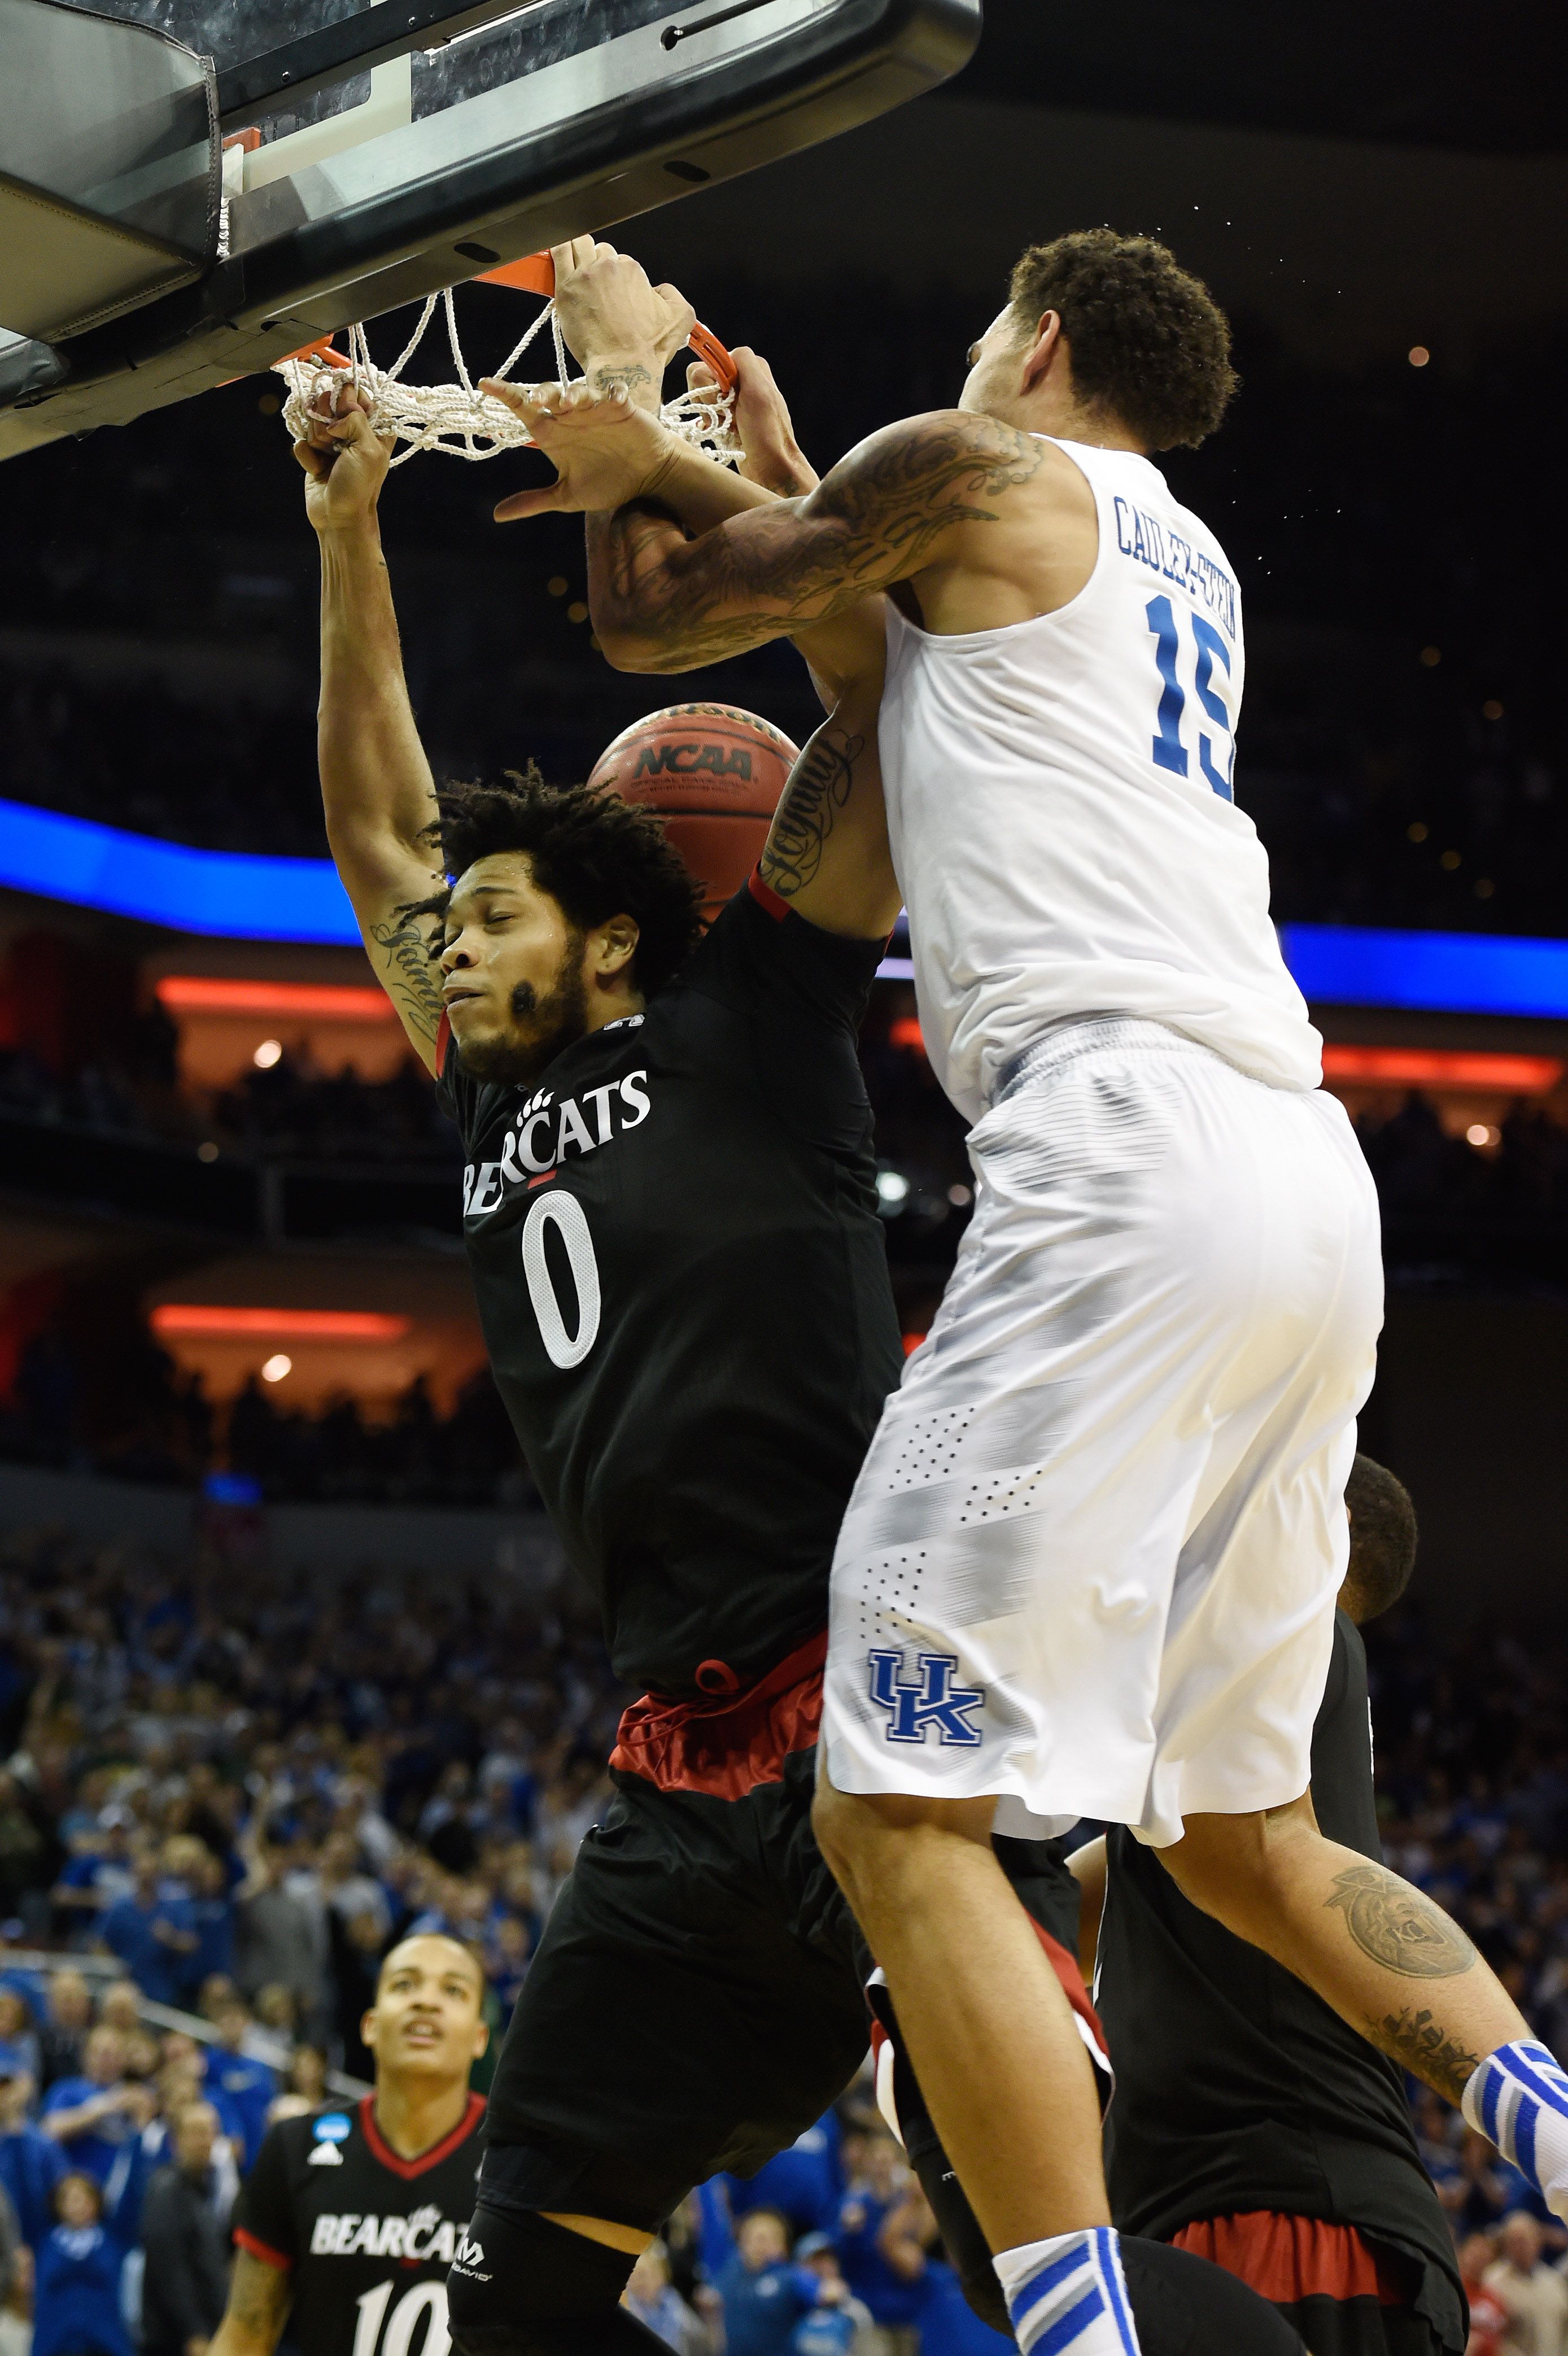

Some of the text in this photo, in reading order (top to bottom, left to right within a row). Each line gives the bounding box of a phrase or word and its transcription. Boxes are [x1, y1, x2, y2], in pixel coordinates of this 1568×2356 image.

[1113, 496, 1235, 643] CAULEY-STEIN
[1145, 594, 1235, 804] 15
[632, 744, 752, 782] NCAA
[522, 1189, 601, 1369] 0
[868, 1648, 985, 1747] UK
[309, 2205, 470, 2262] BEARCAT
[352, 2278, 452, 2356] 10
